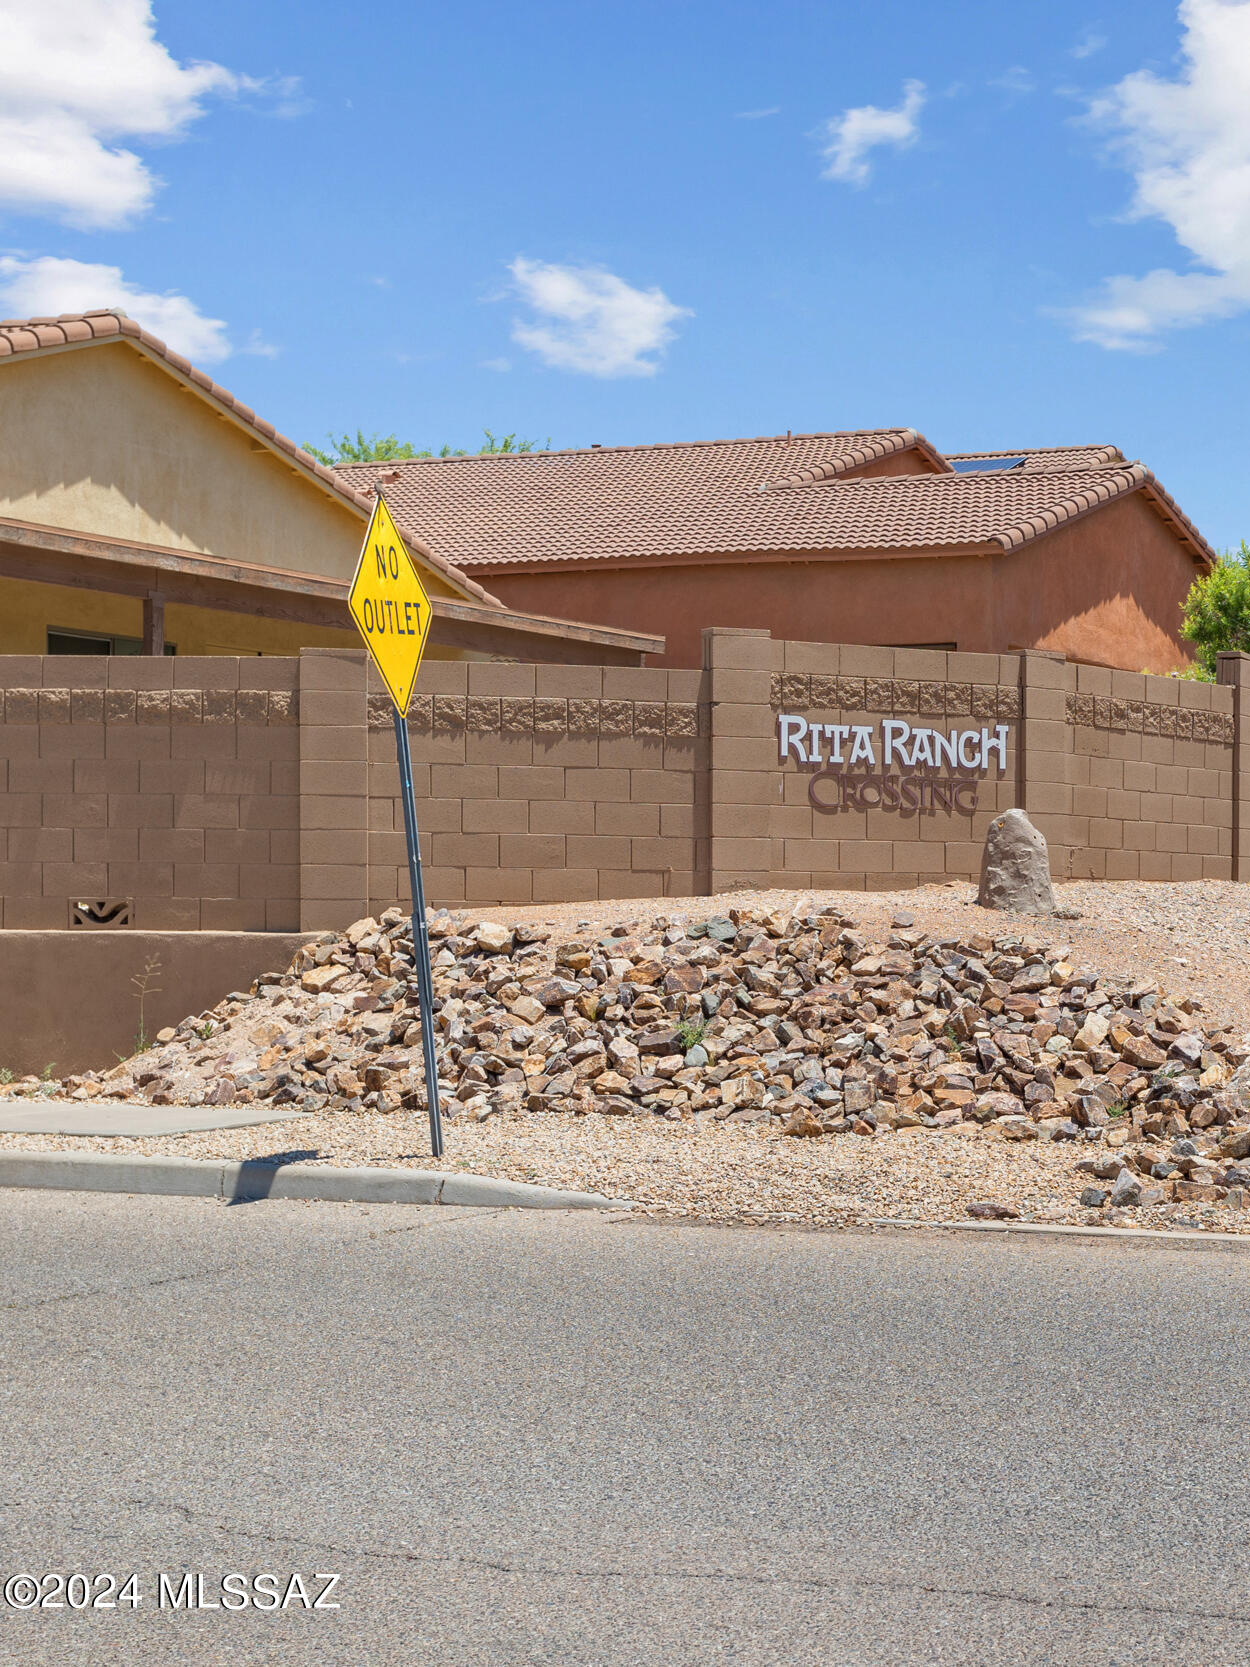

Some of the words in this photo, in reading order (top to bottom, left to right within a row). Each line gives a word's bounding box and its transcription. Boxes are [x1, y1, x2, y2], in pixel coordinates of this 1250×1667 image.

[375, 544, 399, 580] NO
[363, 598, 422, 636] OUTLET
[777, 714, 876, 765] RITA
[881, 719, 1009, 770] RANCH
[808, 768, 979, 811] CROSSING
